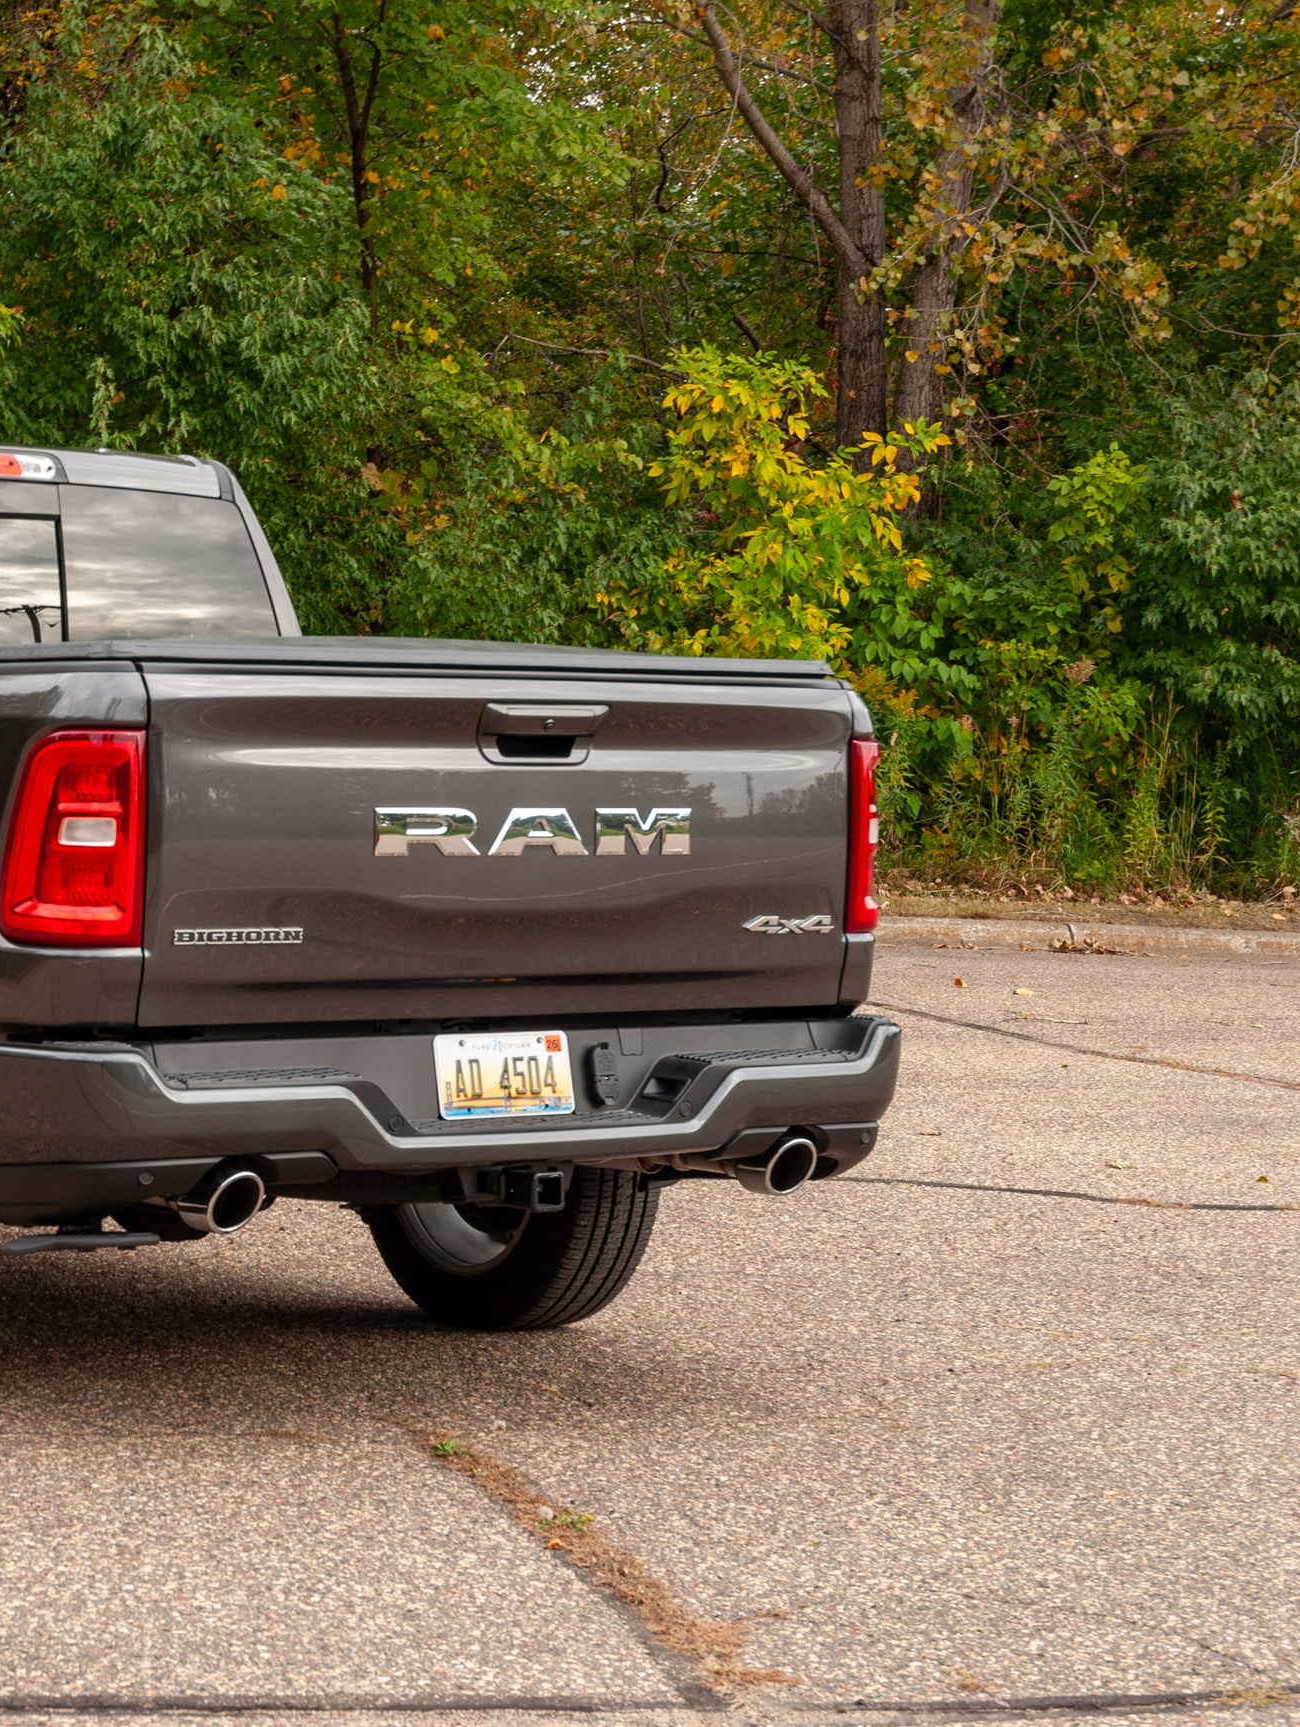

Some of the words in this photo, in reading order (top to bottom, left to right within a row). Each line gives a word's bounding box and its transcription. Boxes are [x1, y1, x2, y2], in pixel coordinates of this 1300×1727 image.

[374, 807, 692, 857] RAM
[173, 928, 303, 946] BIGHORN
[742, 914, 835, 935] 4x4
[455, 1058, 483, 1098] AD
[500, 1055, 557, 1095] 4504
